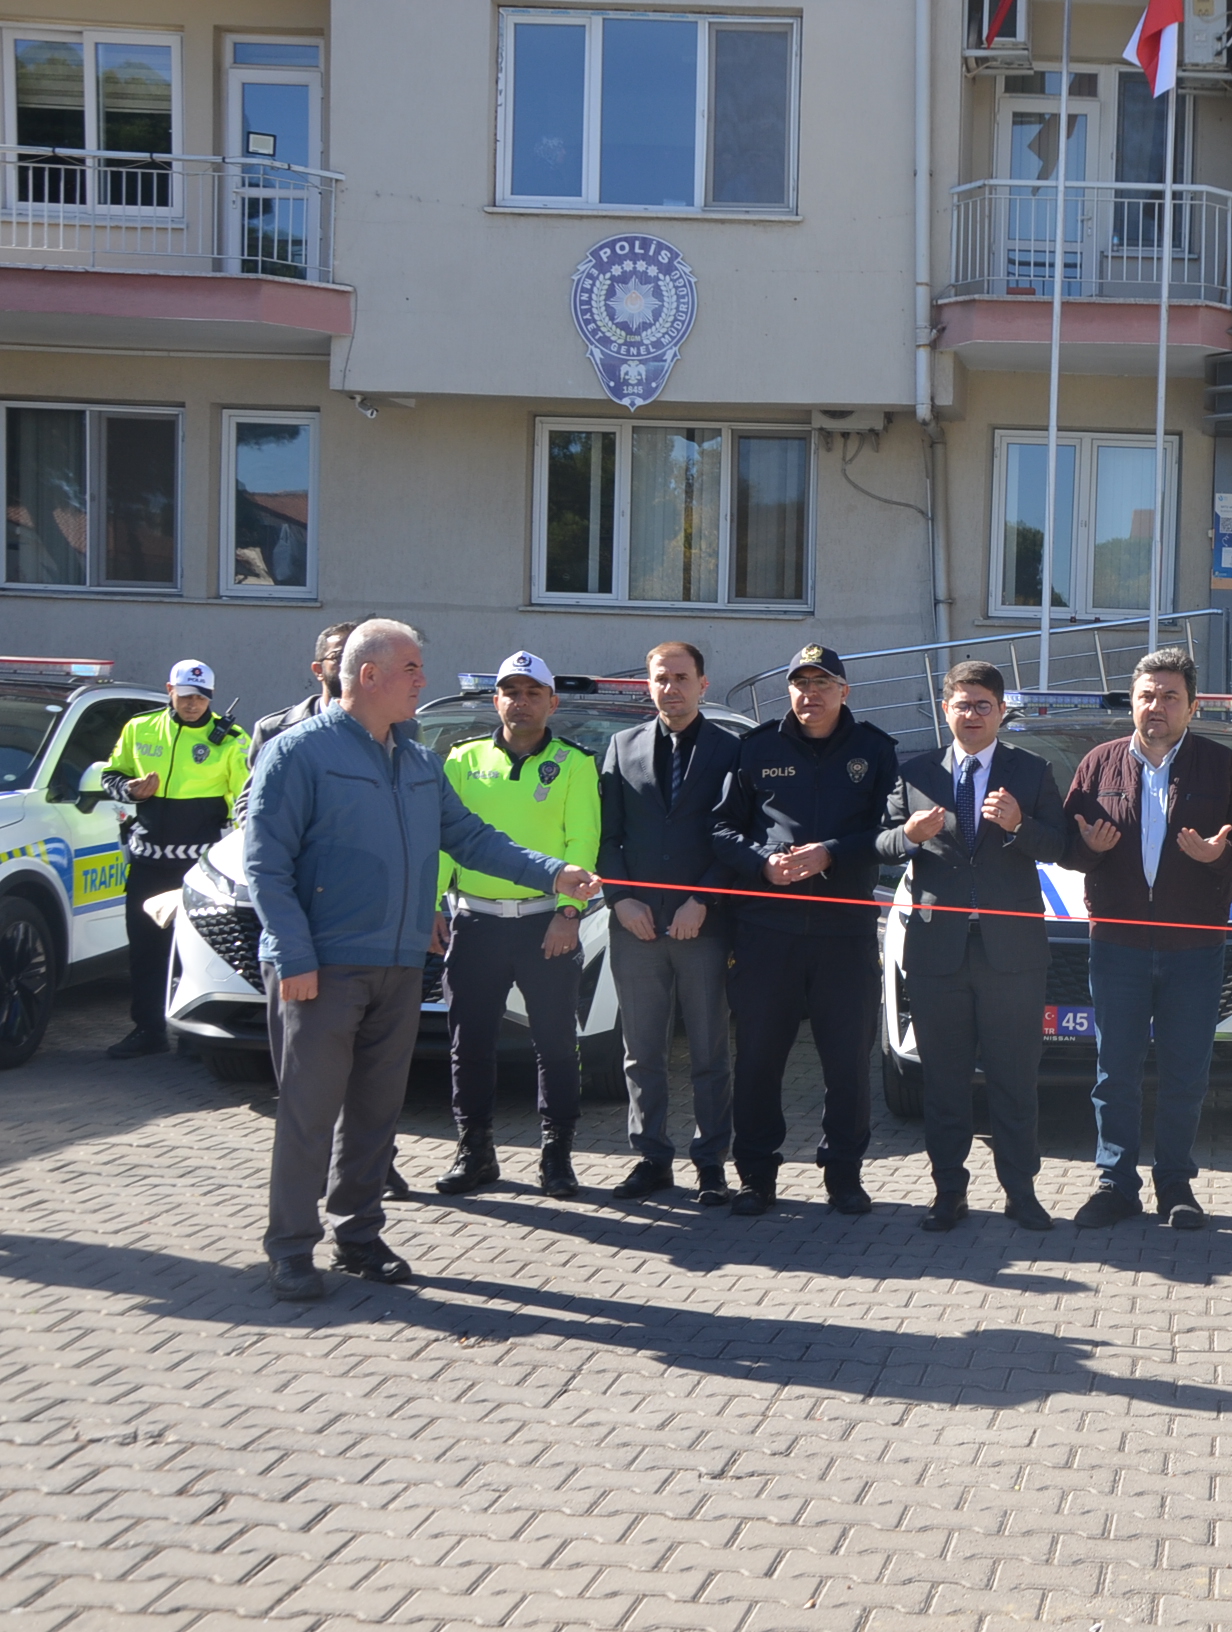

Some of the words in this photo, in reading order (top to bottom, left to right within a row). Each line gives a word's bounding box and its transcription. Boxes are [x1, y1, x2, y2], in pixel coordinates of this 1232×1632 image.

[610, 342, 656, 356] GENEL
[622, 386, 644, 394] 1845
[82, 856, 129, 894] TRAFİK
[1044, 1027, 1055, 1035] TR
[1061, 1012, 1089, 1031] 45
